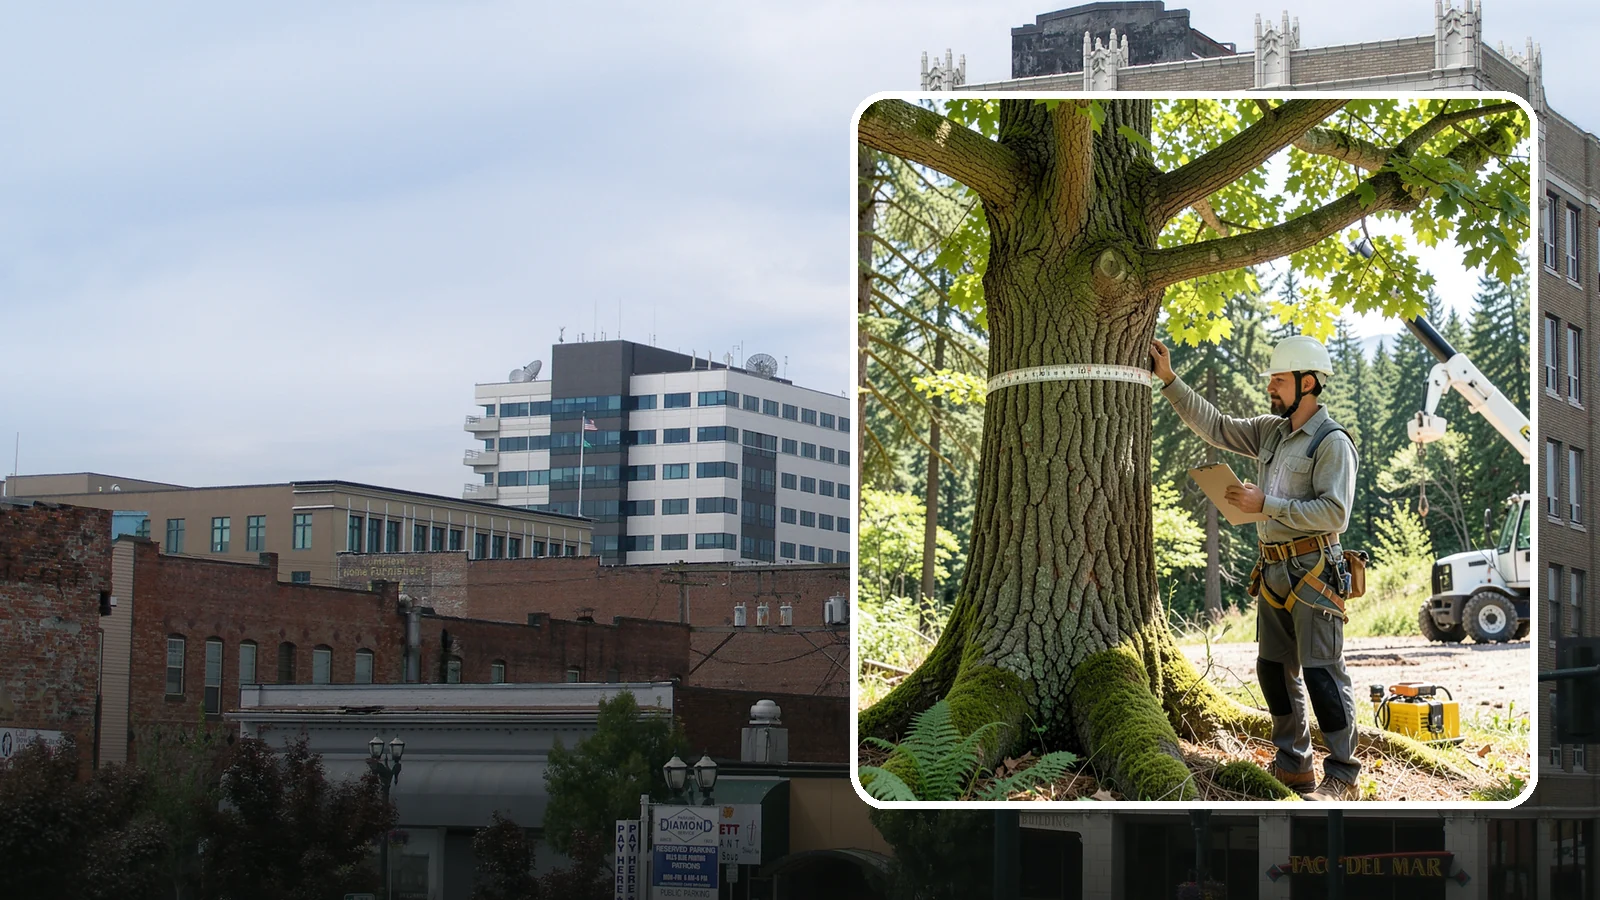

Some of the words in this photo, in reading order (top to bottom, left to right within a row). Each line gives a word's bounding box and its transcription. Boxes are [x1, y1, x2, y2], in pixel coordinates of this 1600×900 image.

[343, 568, 368, 577] Home
[370, 566, 427, 576] Furnishers
[1022, 815, 1070, 828] BUILDING
[719, 824, 740, 835] ETT
[617, 825, 625, 853] PAY
[628, 825, 636, 853] PAY
[719, 839, 740, 848] ANT
[656, 845, 687, 853] RESERVED
[689, 846, 716, 854] PARKING
[721, 851, 739, 862] Soup
[671, 862, 701, 870] PATRONS
[1289, 855, 1330, 874] TAC
[1346, 856, 1385, 875] DEL
[1392, 857, 1442, 877] MAR
[616, 856, 625, 894] HERE
[627, 856, 636, 893] HERE
[660, 889, 682, 897] PUBLIC
[683, 889, 710, 898] PARKING
